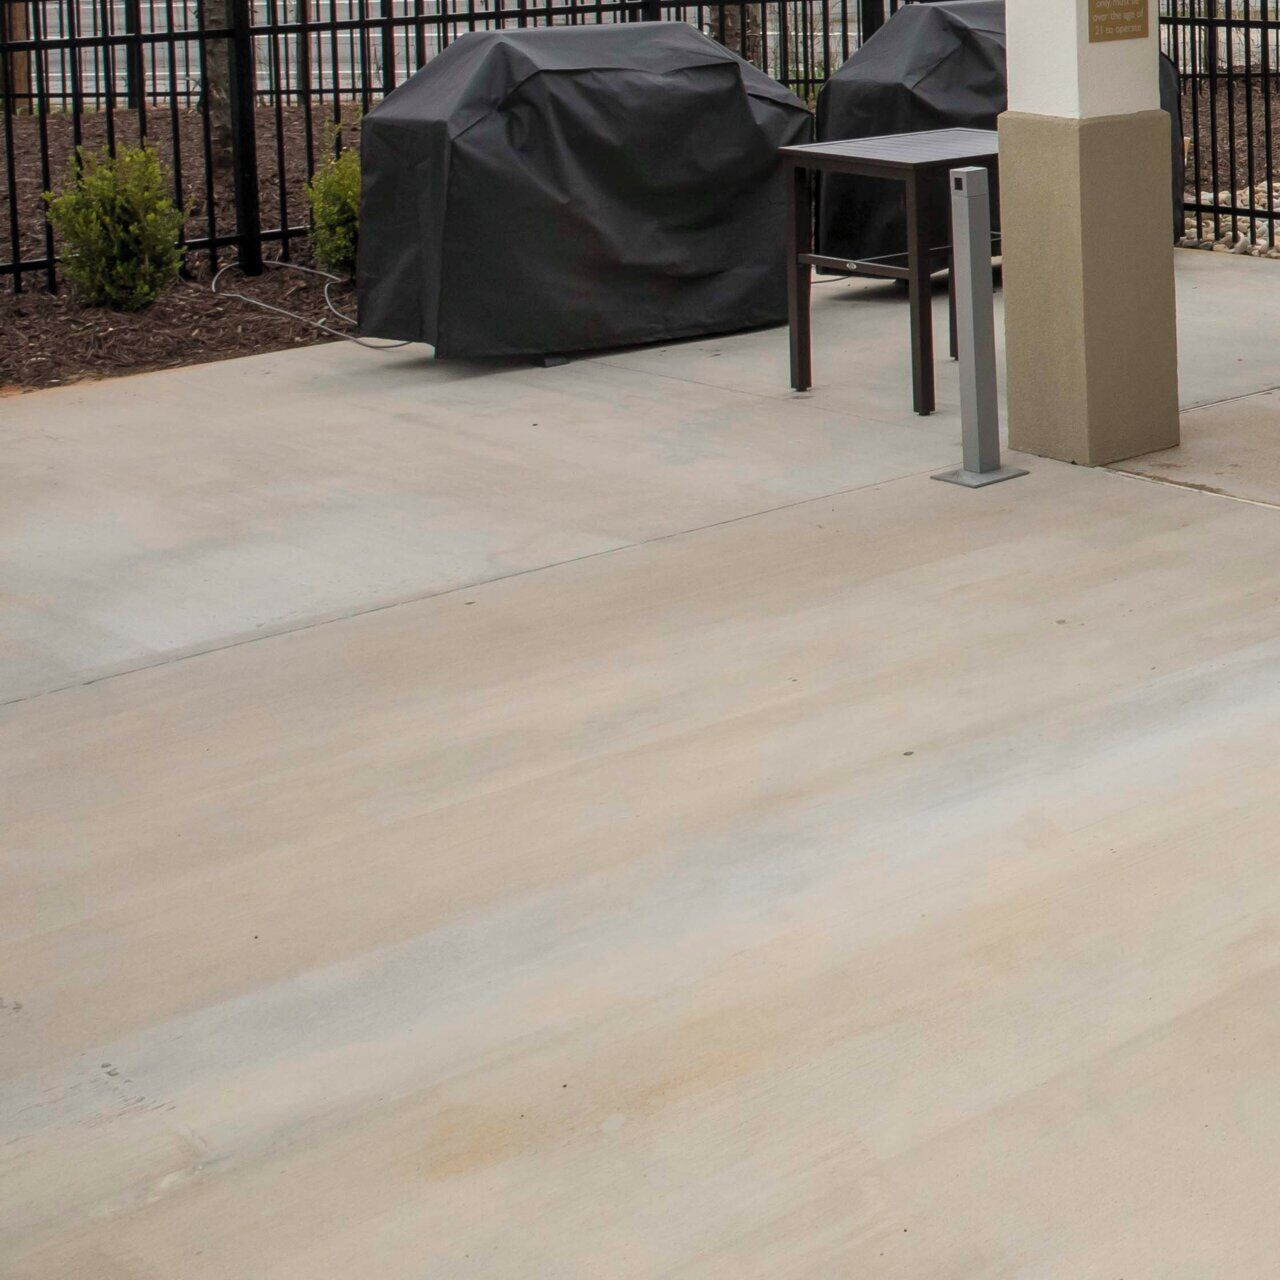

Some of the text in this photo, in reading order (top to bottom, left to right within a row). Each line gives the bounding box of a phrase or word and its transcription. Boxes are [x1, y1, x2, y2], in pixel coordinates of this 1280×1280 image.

[1092, 13, 1108, 22] over
[1110, 10, 1122, 20] the
[1136, 8, 1144, 18] of
[1095, 24, 1103, 35] 21
